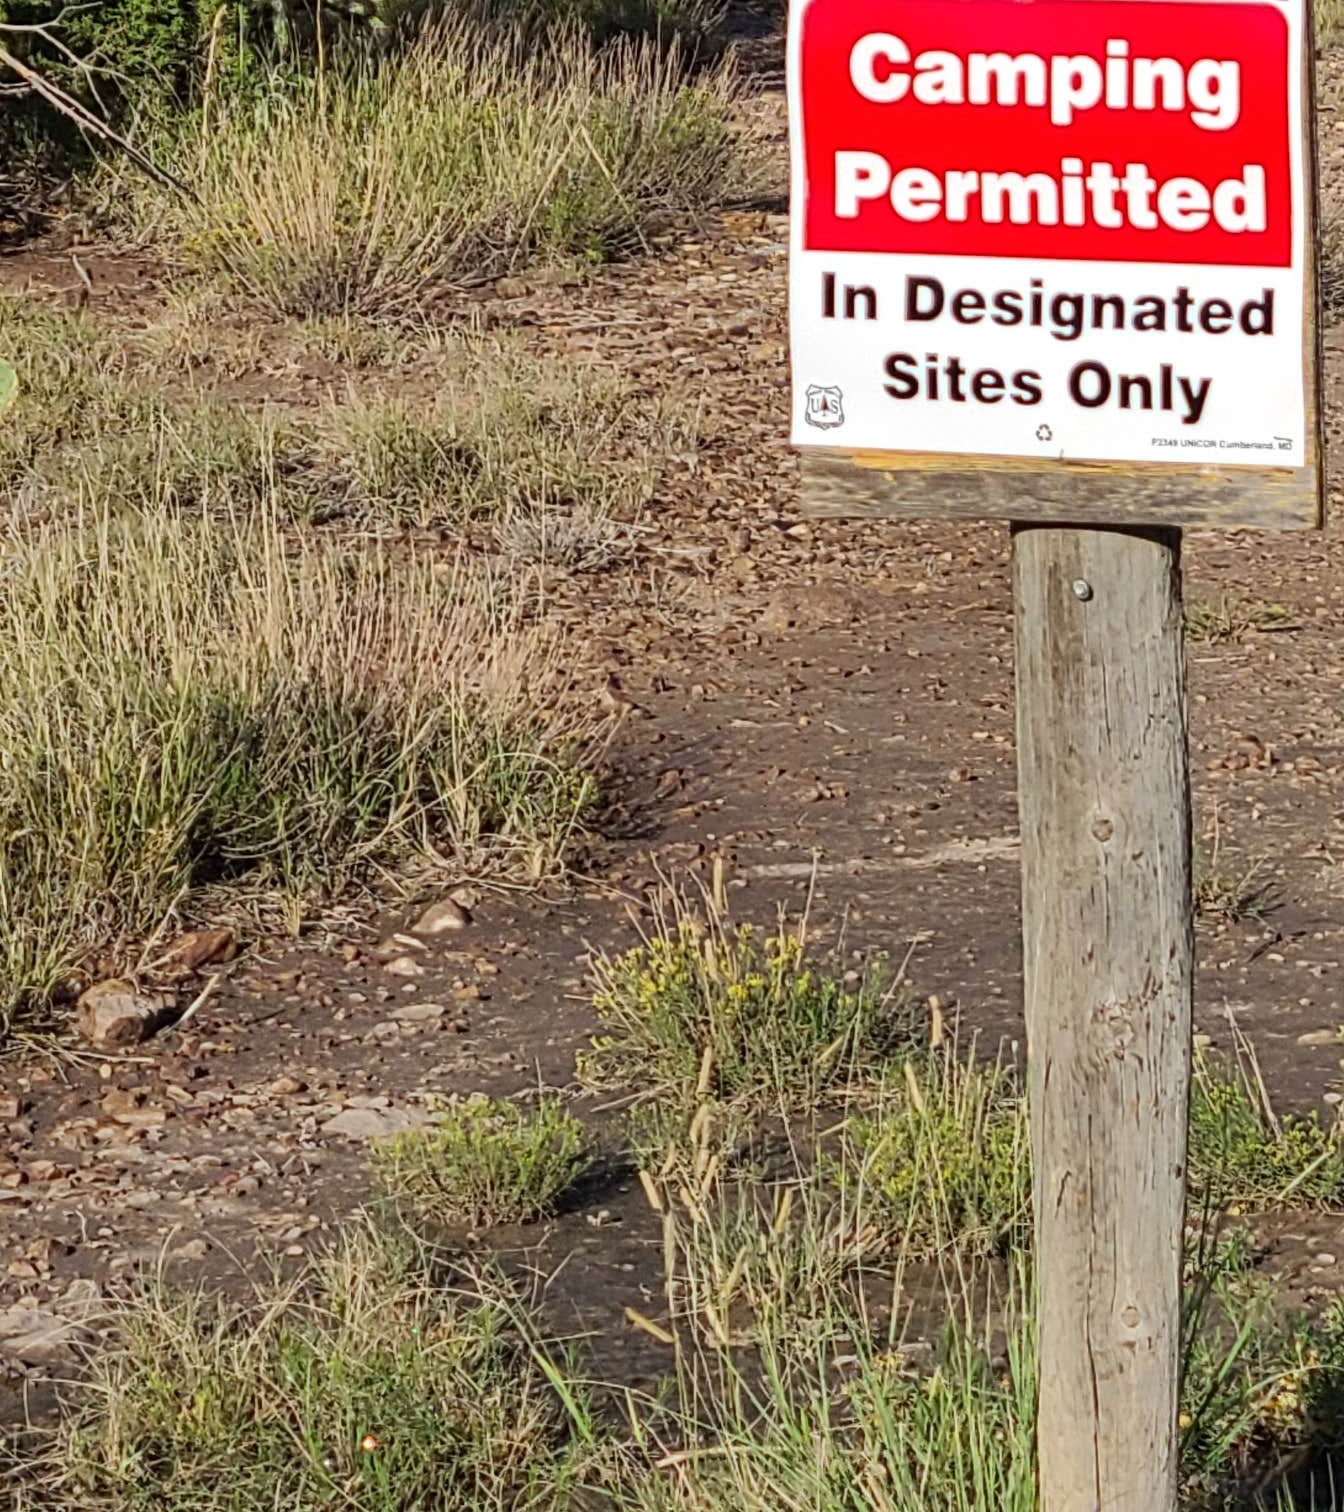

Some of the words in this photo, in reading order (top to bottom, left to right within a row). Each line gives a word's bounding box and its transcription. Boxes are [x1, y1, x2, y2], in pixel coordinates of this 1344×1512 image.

[849, 32, 1241, 131] Camping
[833, 150, 1268, 233] Permitted
[821, 271, 878, 320] In
[905, 274, 1275, 341] Designated
[883, 352, 1043, 406] Sites
[1068, 360, 1212, 425] Only
